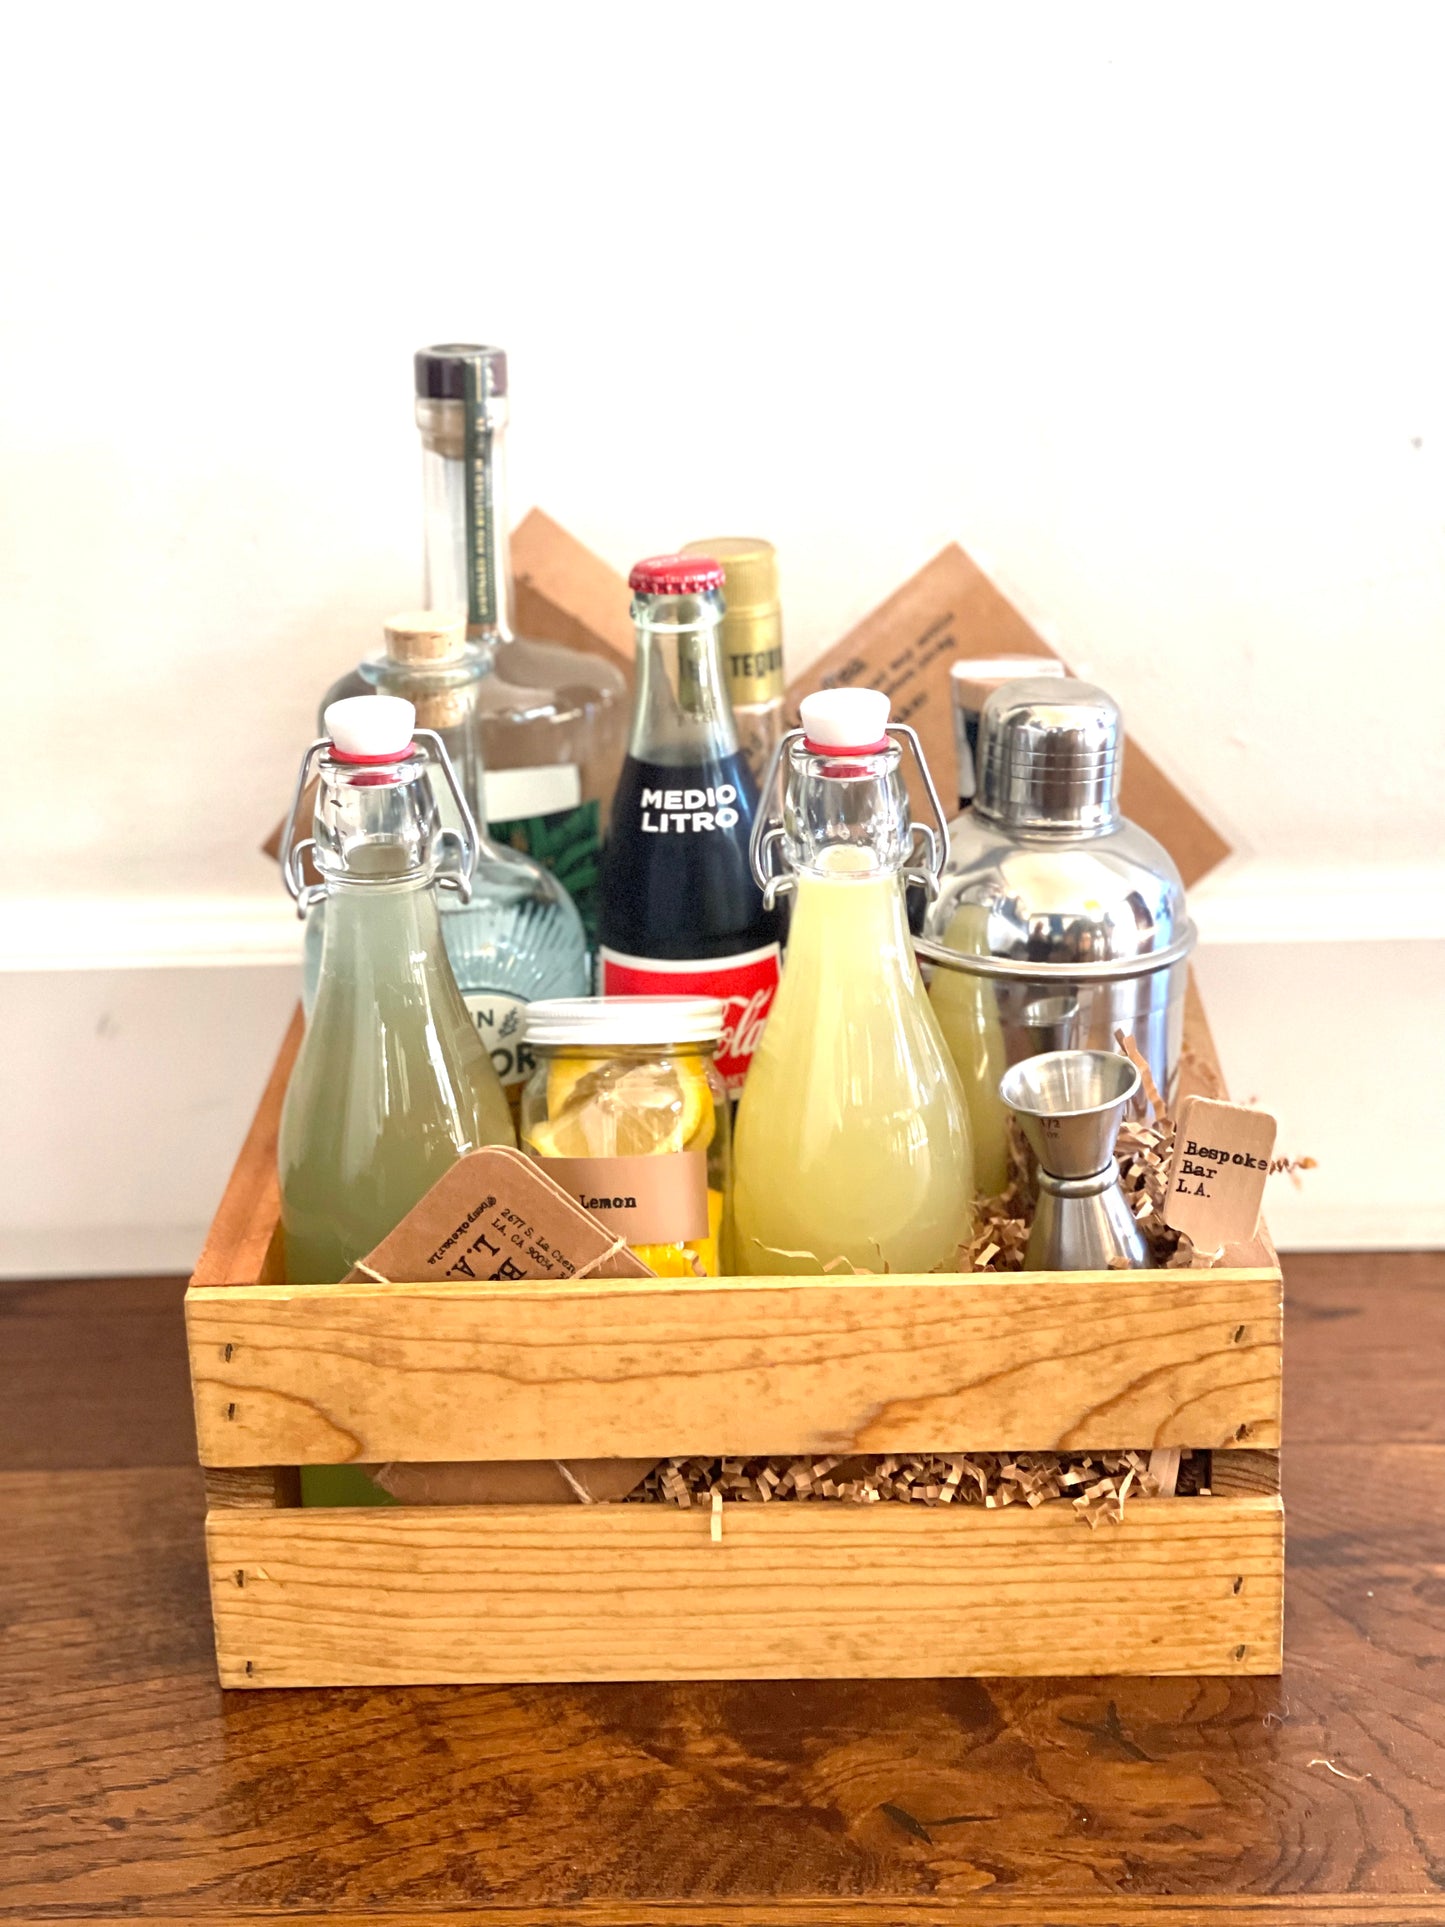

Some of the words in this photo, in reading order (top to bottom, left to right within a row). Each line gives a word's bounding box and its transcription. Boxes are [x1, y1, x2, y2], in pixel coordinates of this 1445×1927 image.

[640, 784, 738, 810] MEDIO
[641, 807, 739, 834] LITRO
[1184, 1140, 1268, 1172] Bespoke
[1179, 1159, 1218, 1180] Bar
[1175, 1178, 1211, 1198] L.A.
[579, 1194, 637, 1210] Lemon
[500, 1208, 526, 1229] 2677
[551, 1249, 577, 1275] Cien
[510, 1233, 525, 1249] CA
[445, 1233, 501, 1278] L.A.
